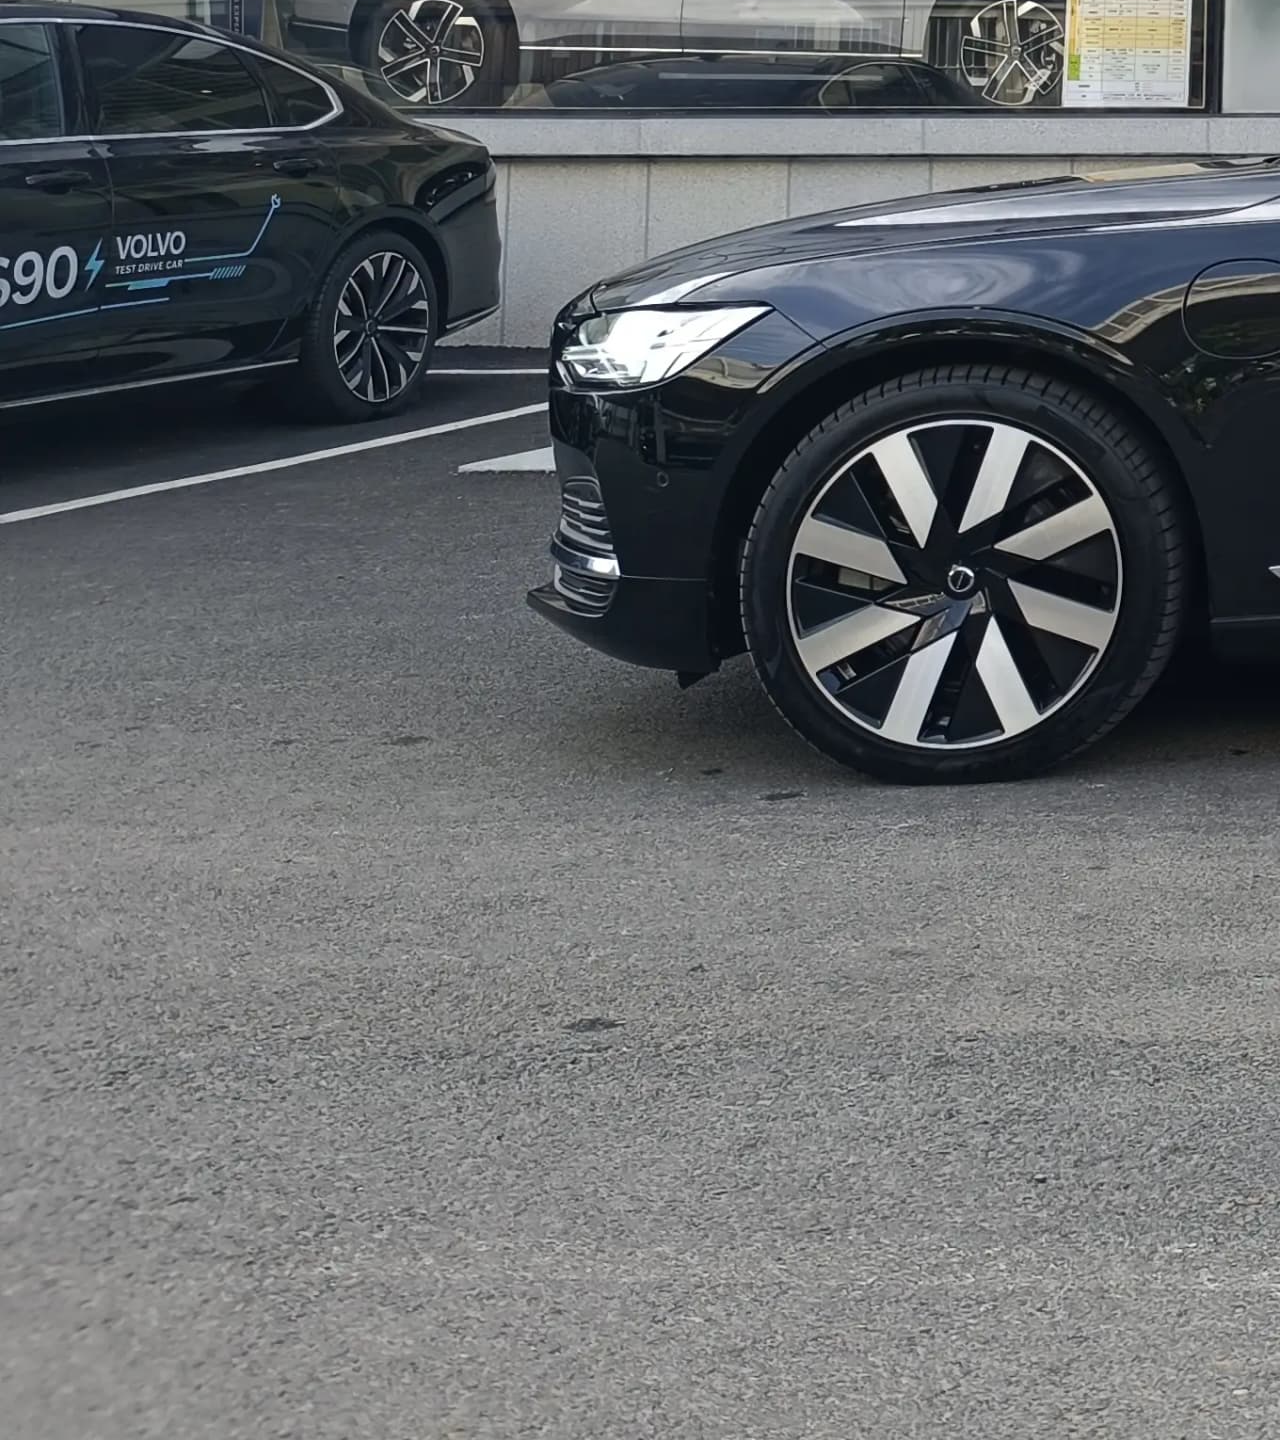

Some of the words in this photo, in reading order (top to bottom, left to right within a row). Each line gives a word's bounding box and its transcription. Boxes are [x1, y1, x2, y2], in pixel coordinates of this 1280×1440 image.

[116, 231, 187, 259] VOLVO
[115, 263, 136, 275] TEST
[138, 261, 163, 273] DRIVE
[165, 259, 183, 269] CAR
